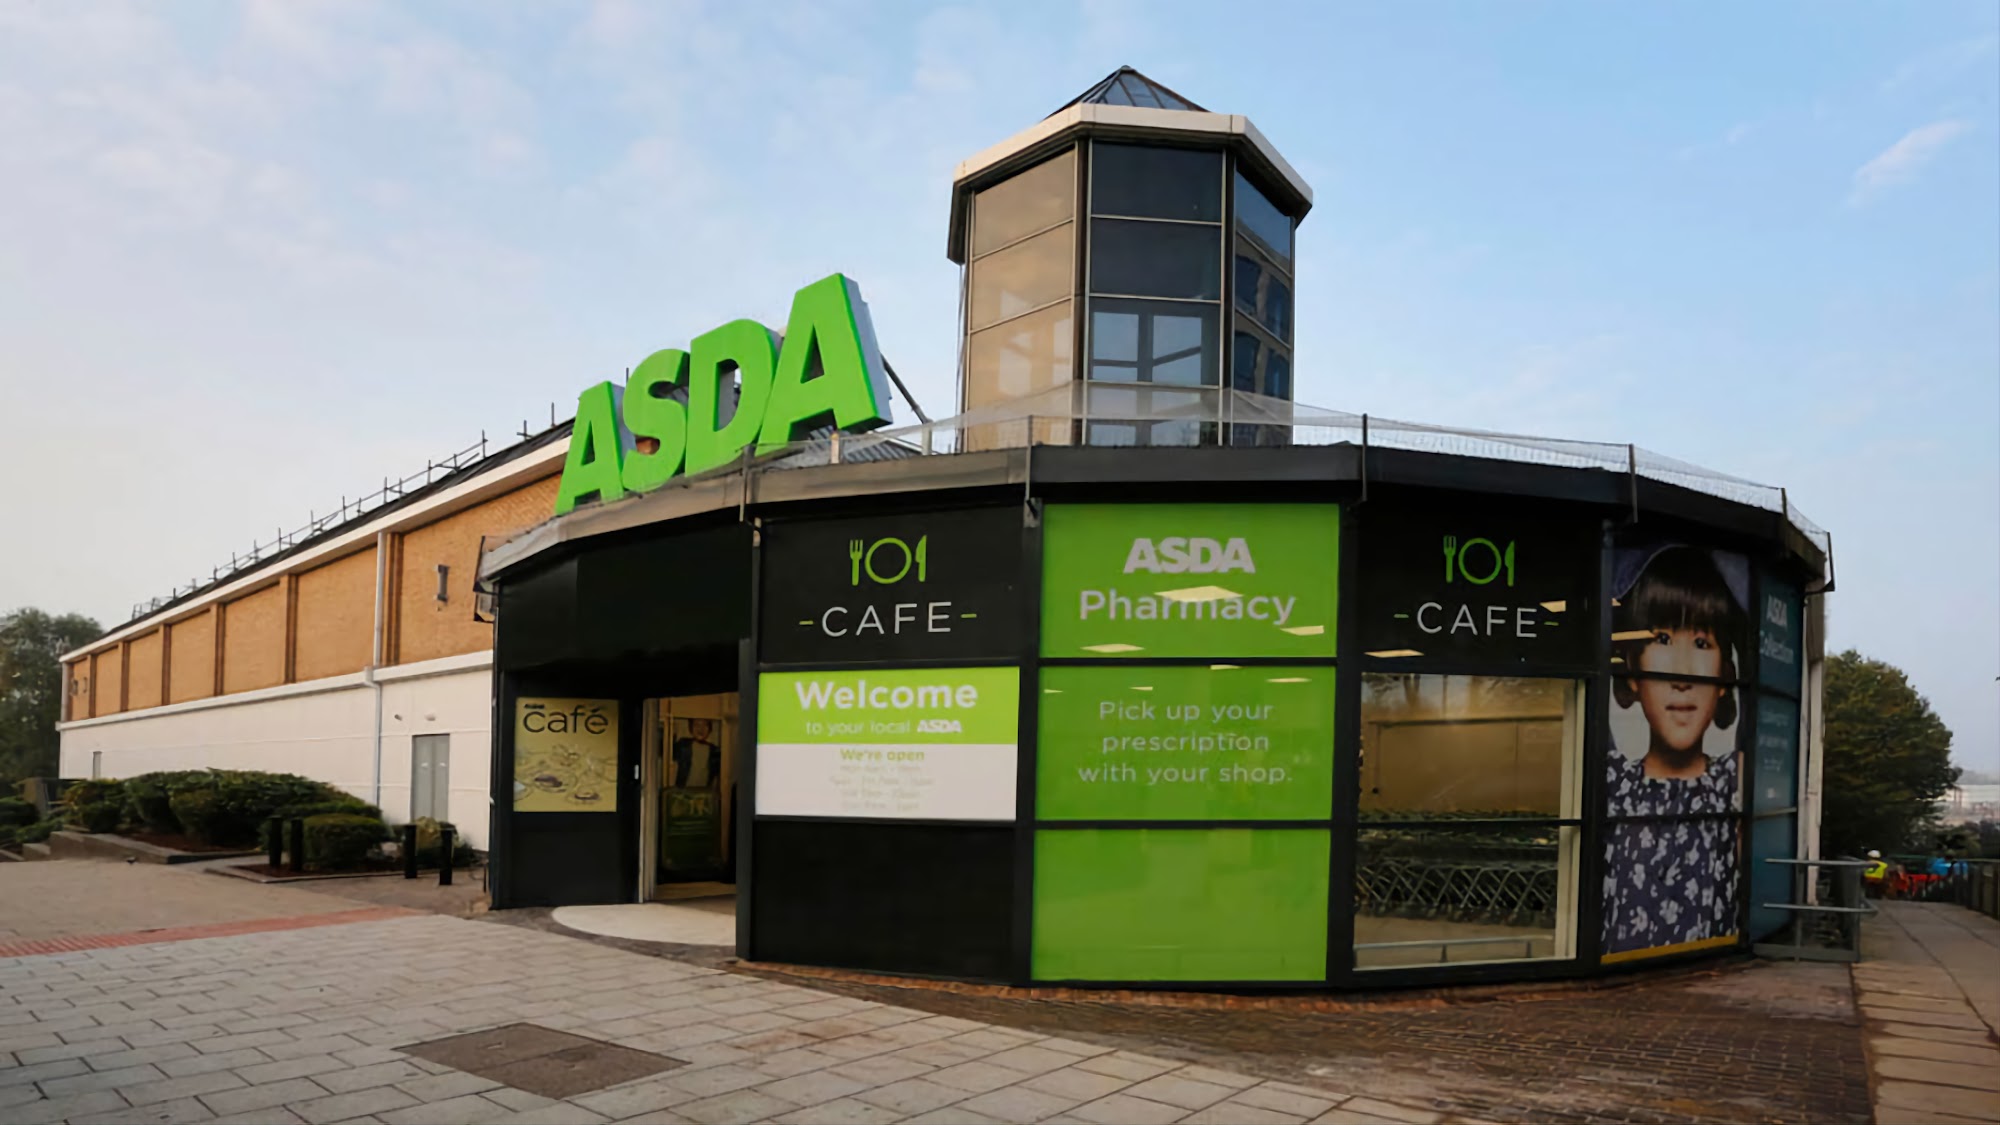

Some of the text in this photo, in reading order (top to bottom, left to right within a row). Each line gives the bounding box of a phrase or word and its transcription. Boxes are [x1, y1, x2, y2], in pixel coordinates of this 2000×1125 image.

[554, 272, 893, 516] ASDA
[1123, 537, 1256, 574] ASDA
[821, 602, 952, 637] CAFE
[1080, 588, 1297, 625] Pharmacy
[1416, 602, 1537, 638] CAFE
[795, 680, 978, 710] Welcome
[523, 704, 609, 734] café
[1100, 700, 1273, 723] Pick up your
[806, 719, 962, 736] to your local ASDA
[840, 748, 925, 762] We're open
[1102, 732, 1269, 754] prescription
[1078, 762, 1292, 785] with your shop.
